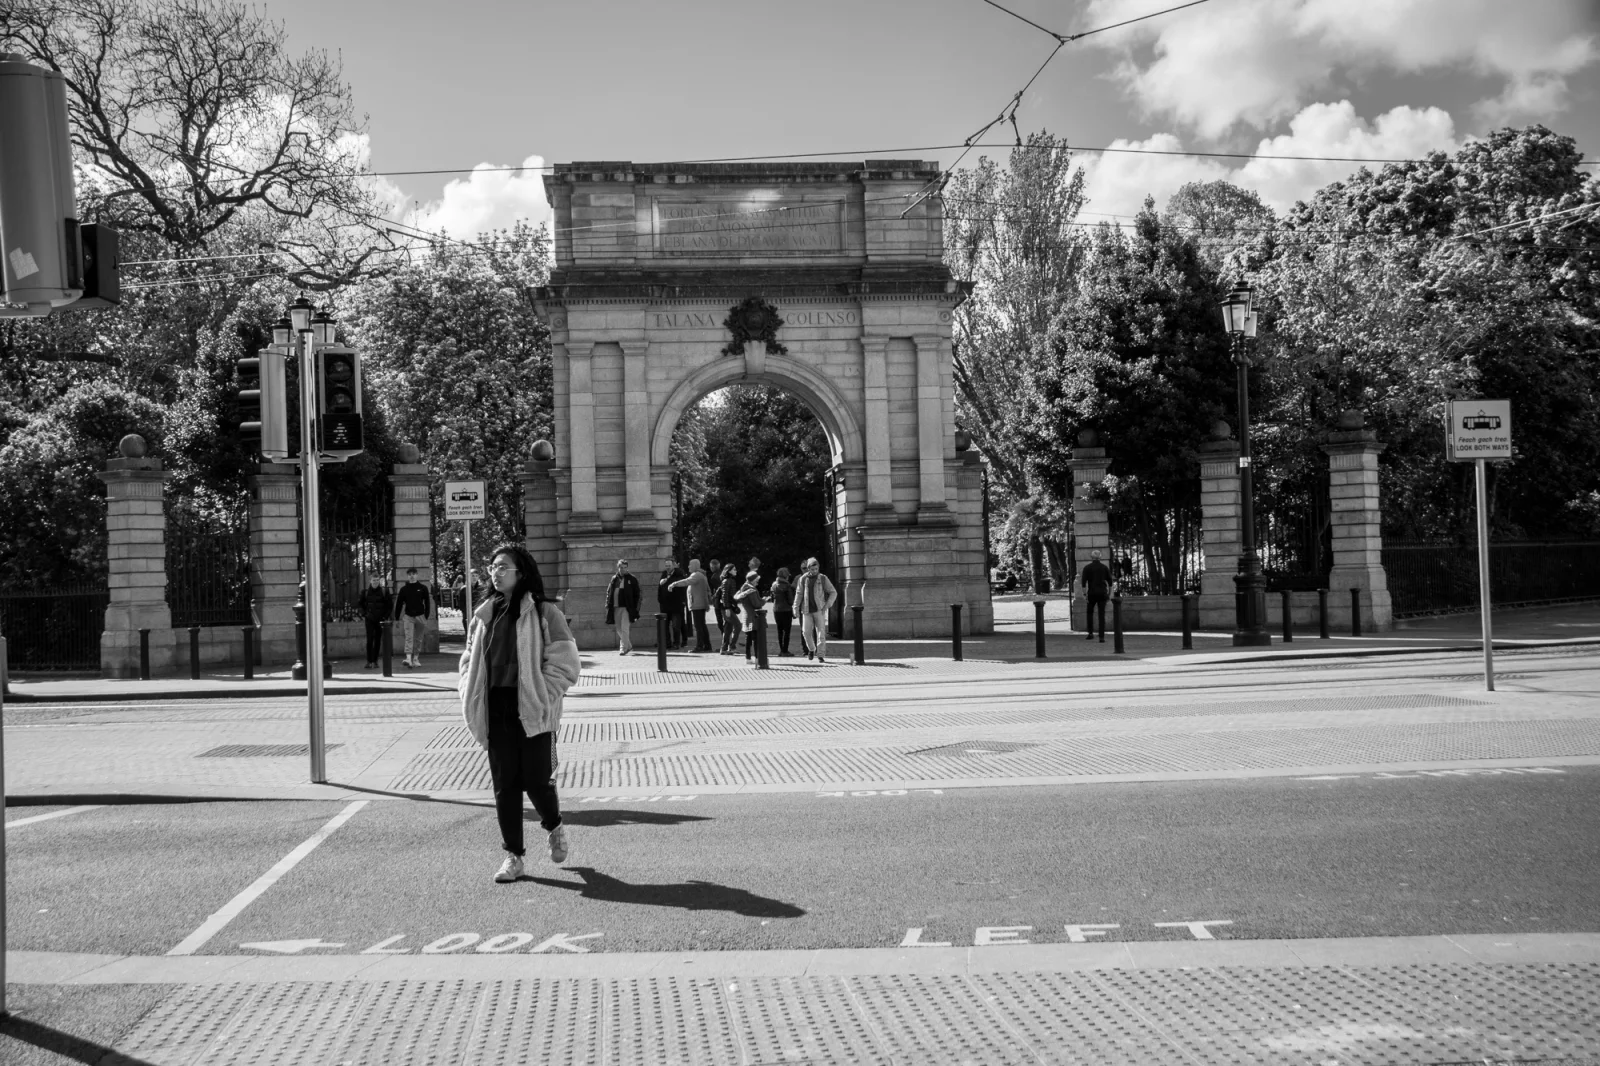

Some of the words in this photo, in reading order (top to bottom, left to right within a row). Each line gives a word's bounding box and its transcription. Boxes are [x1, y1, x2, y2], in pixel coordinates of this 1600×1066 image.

[653, 313, 715, 327] TALANA
[786, 311, 856, 325] COLENSO
[1477, 436, 1493, 444] gach
[359, 931, 605, 955] LOOK
[899, 919, 1234, 947] LEFT
